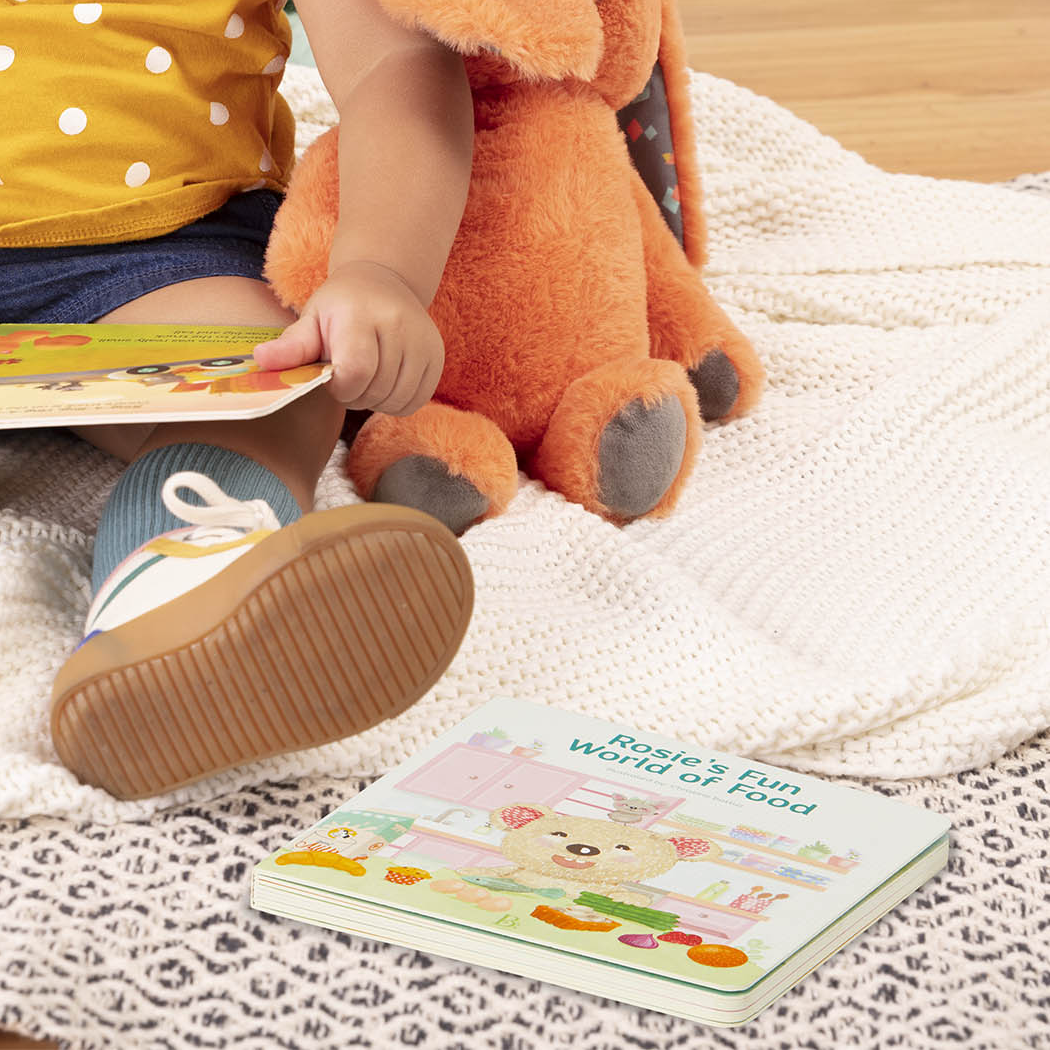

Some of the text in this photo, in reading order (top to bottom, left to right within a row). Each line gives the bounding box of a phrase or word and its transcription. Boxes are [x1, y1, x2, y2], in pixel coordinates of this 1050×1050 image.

[568, 738, 673, 776] World
[678, 771, 725, 788] of
[726, 782, 817, 816] Food
[607, 733, 730, 775] Rosie's
[737, 769, 802, 796] Fun
